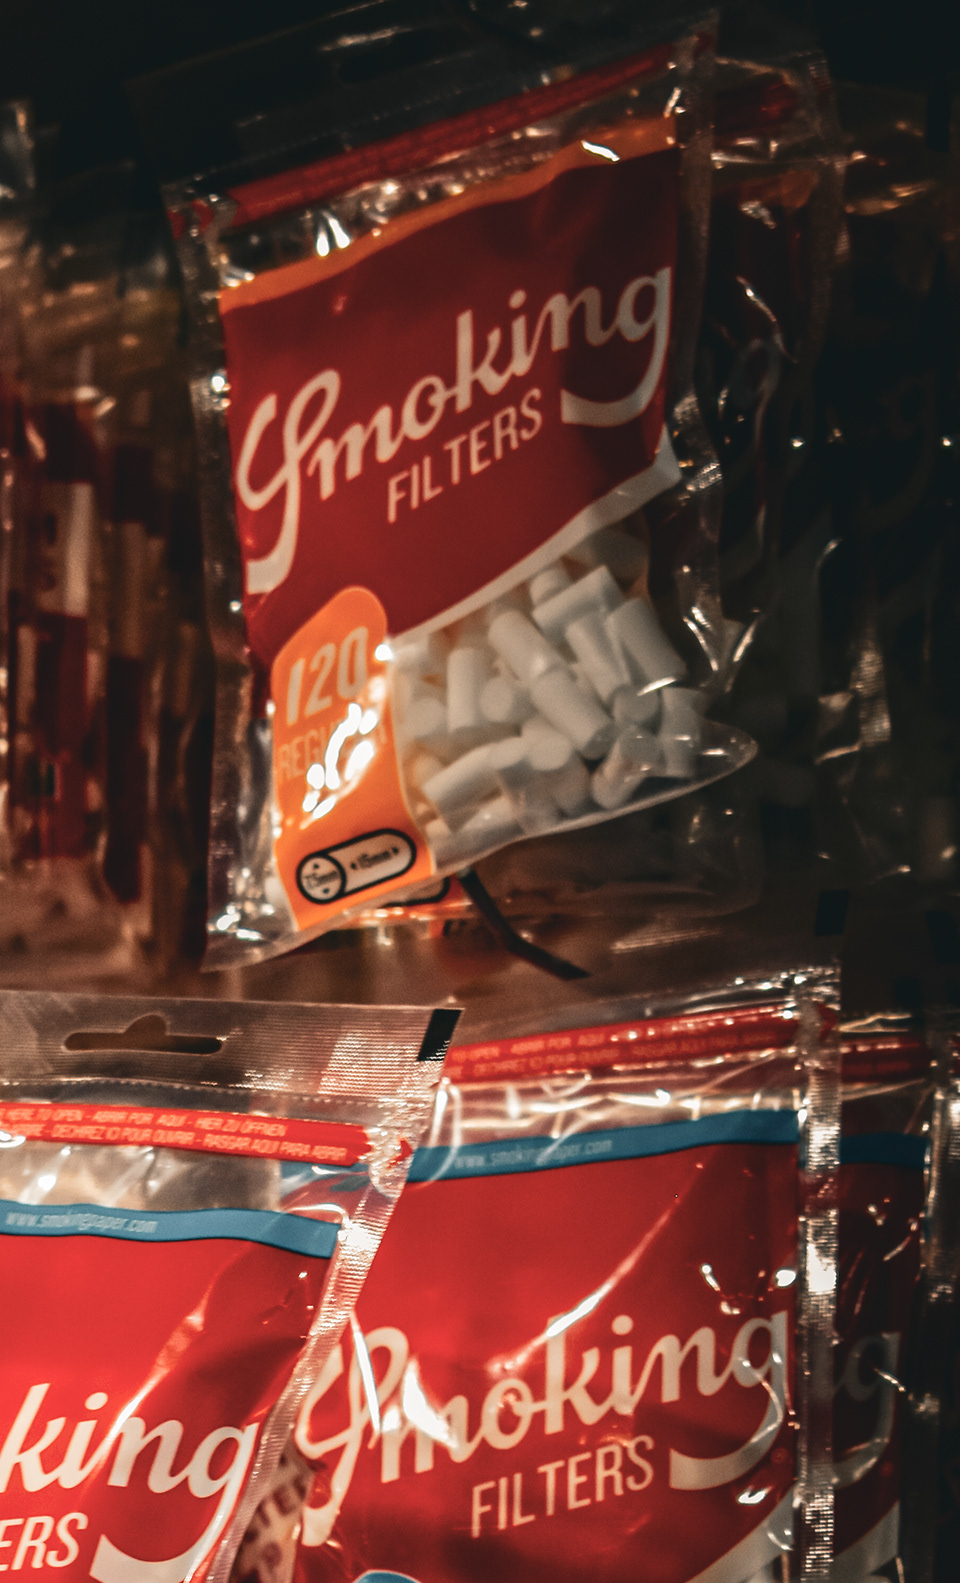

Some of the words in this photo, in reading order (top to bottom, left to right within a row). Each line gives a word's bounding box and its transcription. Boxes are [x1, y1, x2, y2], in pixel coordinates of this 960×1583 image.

[235, 266, 672, 595] Smoking
[387, 387, 543, 523] FILTERS
[286, 626, 369, 726] 120
[294, 1309, 790, 1548] Smoking
[470, 1434, 655, 1540] FILTERS
